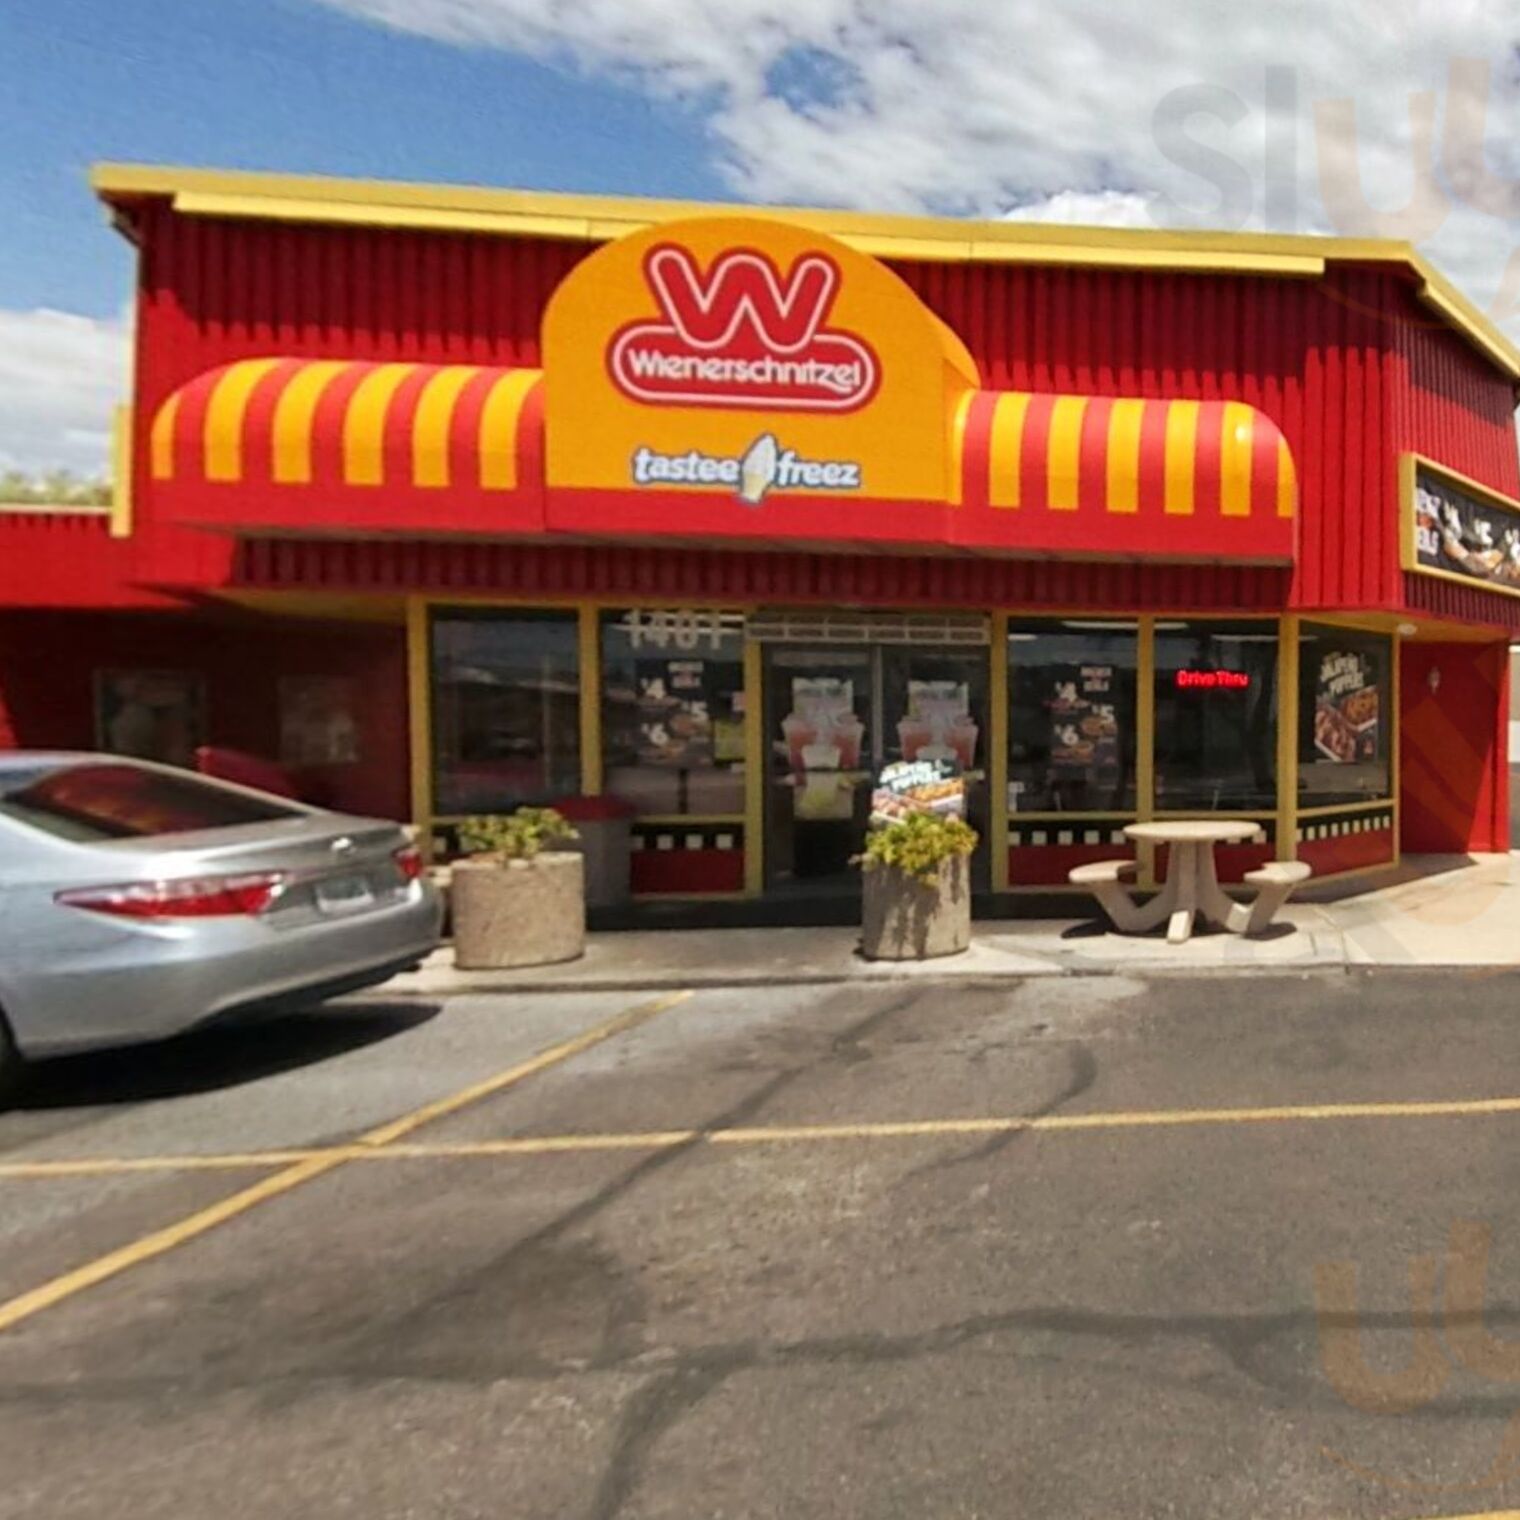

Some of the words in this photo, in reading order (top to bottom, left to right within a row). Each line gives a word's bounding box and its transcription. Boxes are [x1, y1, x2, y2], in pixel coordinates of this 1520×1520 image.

[628, 348, 861, 394] Wienerschnitzel
[634, 447, 740, 484] tastee
[777, 450, 860, 487] freez
